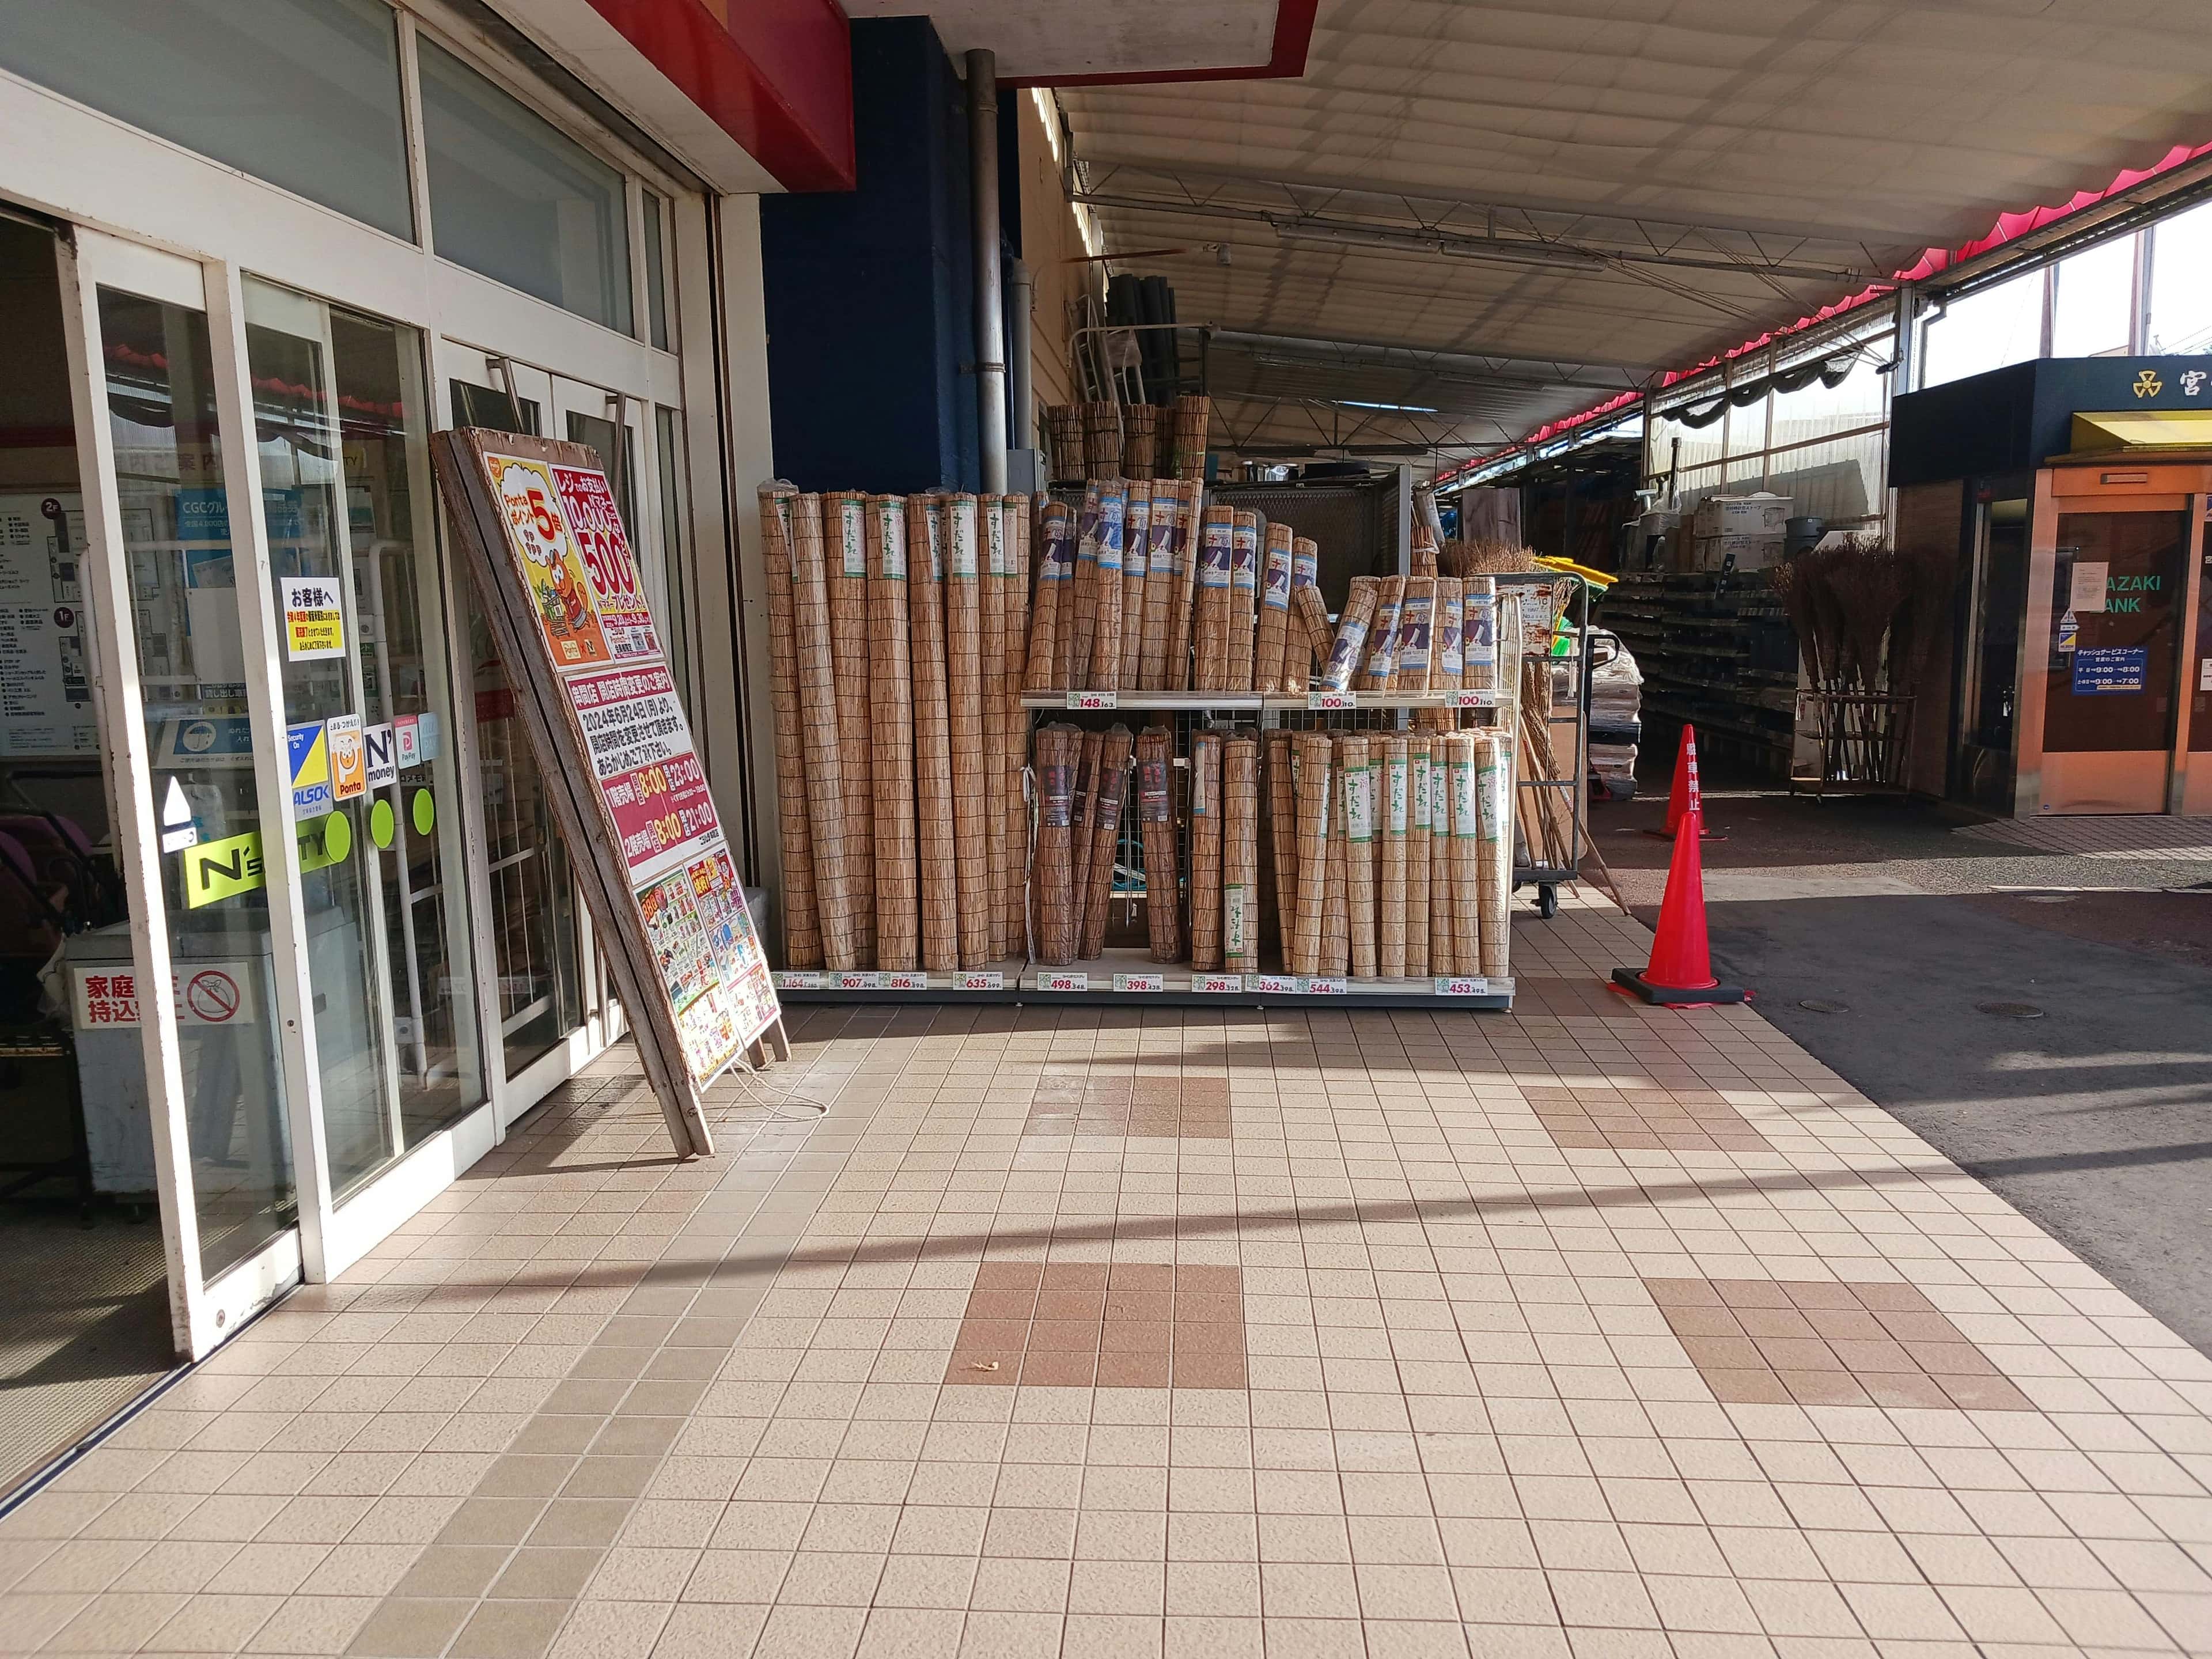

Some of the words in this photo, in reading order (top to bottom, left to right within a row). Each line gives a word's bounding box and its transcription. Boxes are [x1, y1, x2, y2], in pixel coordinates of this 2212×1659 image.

[2180, 370, 2212, 396] 宮
[46, 502, 58, 512] 2F
[183, 502, 228, 514] CGCグル
[503, 494, 528, 508] Ponta
[845, 512, 857, 554] すだれ
[884, 514, 896, 555] すだれ
[953, 512, 965, 555] すだれ
[990, 513, 1002, 555] すだれ
[577, 532, 635, 594] 500
[2107, 576, 2160, 591] AZAKI
[291, 588, 334, 607] お客様へ
[2104, 598, 2141, 613] ANK
[59, 611, 69, 621] 1F
[1080, 698, 1100, 707] 148
[1322, 698, 1341, 707] 100
[1459, 696, 1479, 705] 100
[288, 732, 304, 742] Security
[402, 752, 416, 761] PayPay
[368, 765, 395, 782] money
[1687, 743, 1700, 810] 駐車禁止
[340, 781, 361, 794] Ponta
[606, 782, 635, 808] 1階売場
[638, 767, 667, 798] 8:00
[671, 759, 700, 787] 23:00
[1415, 766, 1429, 807] すだれ
[294, 785, 329, 805] ALSOK
[1348, 779, 1363, 820] すだれ
[1391, 772, 1404, 813] すだれ
[1433, 774, 1446, 814] すだれ
[1456, 776, 1469, 816] すだれ
[1478, 781, 1495, 820] すだれ
[654, 813, 682, 845] 8:00
[686, 802, 713, 832] 21:00
[783, 979, 803, 988] 1,164
[842, 979, 862, 988] 907
[891, 979, 910, 988] 816
[967, 979, 986, 988] 635
[1051, 980, 1071, 989] 498
[1127, 980, 1146, 990] 398
[1206, 982, 1225, 991] 298
[1259, 982, 1279, 991] 362
[1309, 984, 1330, 993] 544
[1450, 984, 1470, 993] 453
